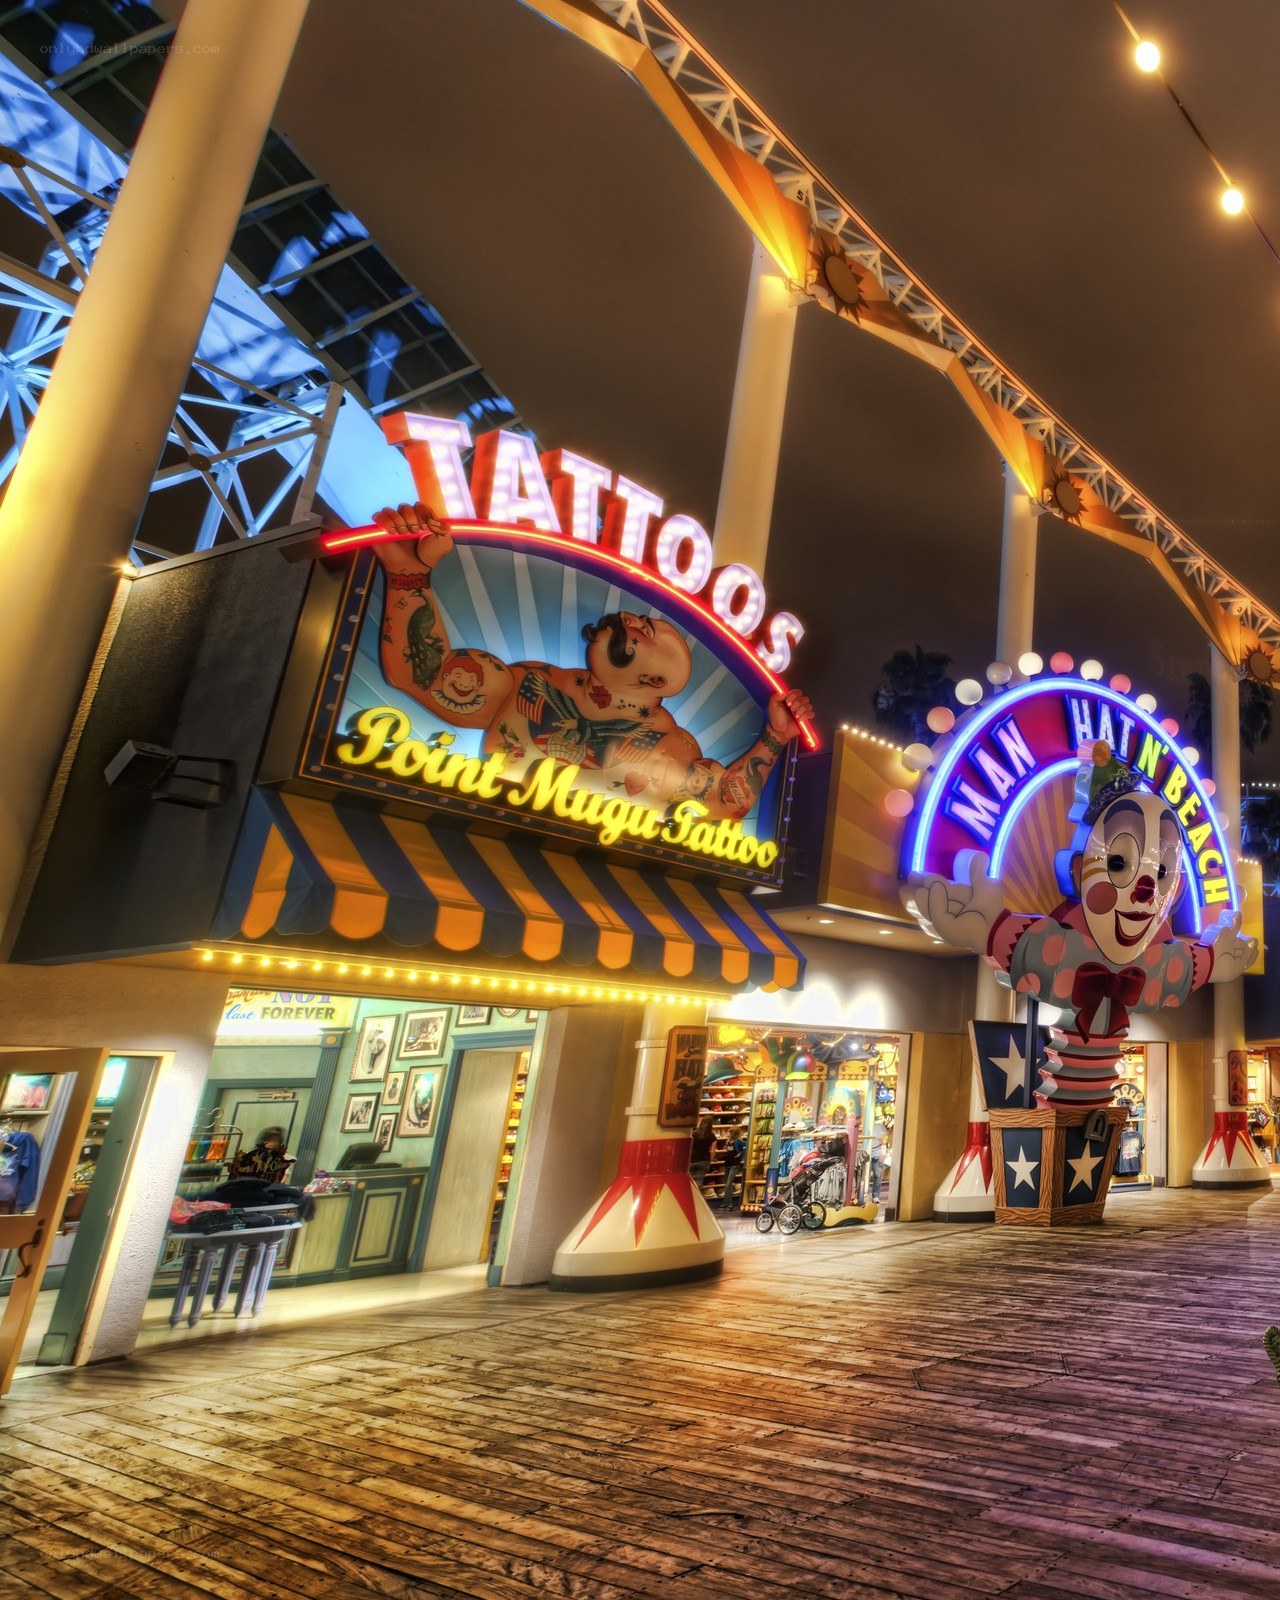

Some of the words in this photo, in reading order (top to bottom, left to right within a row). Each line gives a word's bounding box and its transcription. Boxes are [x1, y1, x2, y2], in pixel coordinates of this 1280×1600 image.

[796, 189, 804, 201] 5
[381, 411, 806, 674] TATTOOS
[336, 706, 507, 799] Point
[507, 756, 661, 846] Mugu
[662, 799, 779, 869] Tattoo
[947, 714, 1037, 843] MAN
[1066, 696, 1135, 760] HAT
[1163, 767, 1230, 904] BEACH
[226, 1003, 255, 1020] last
[260, 1006, 336, 1020] FOREVER
